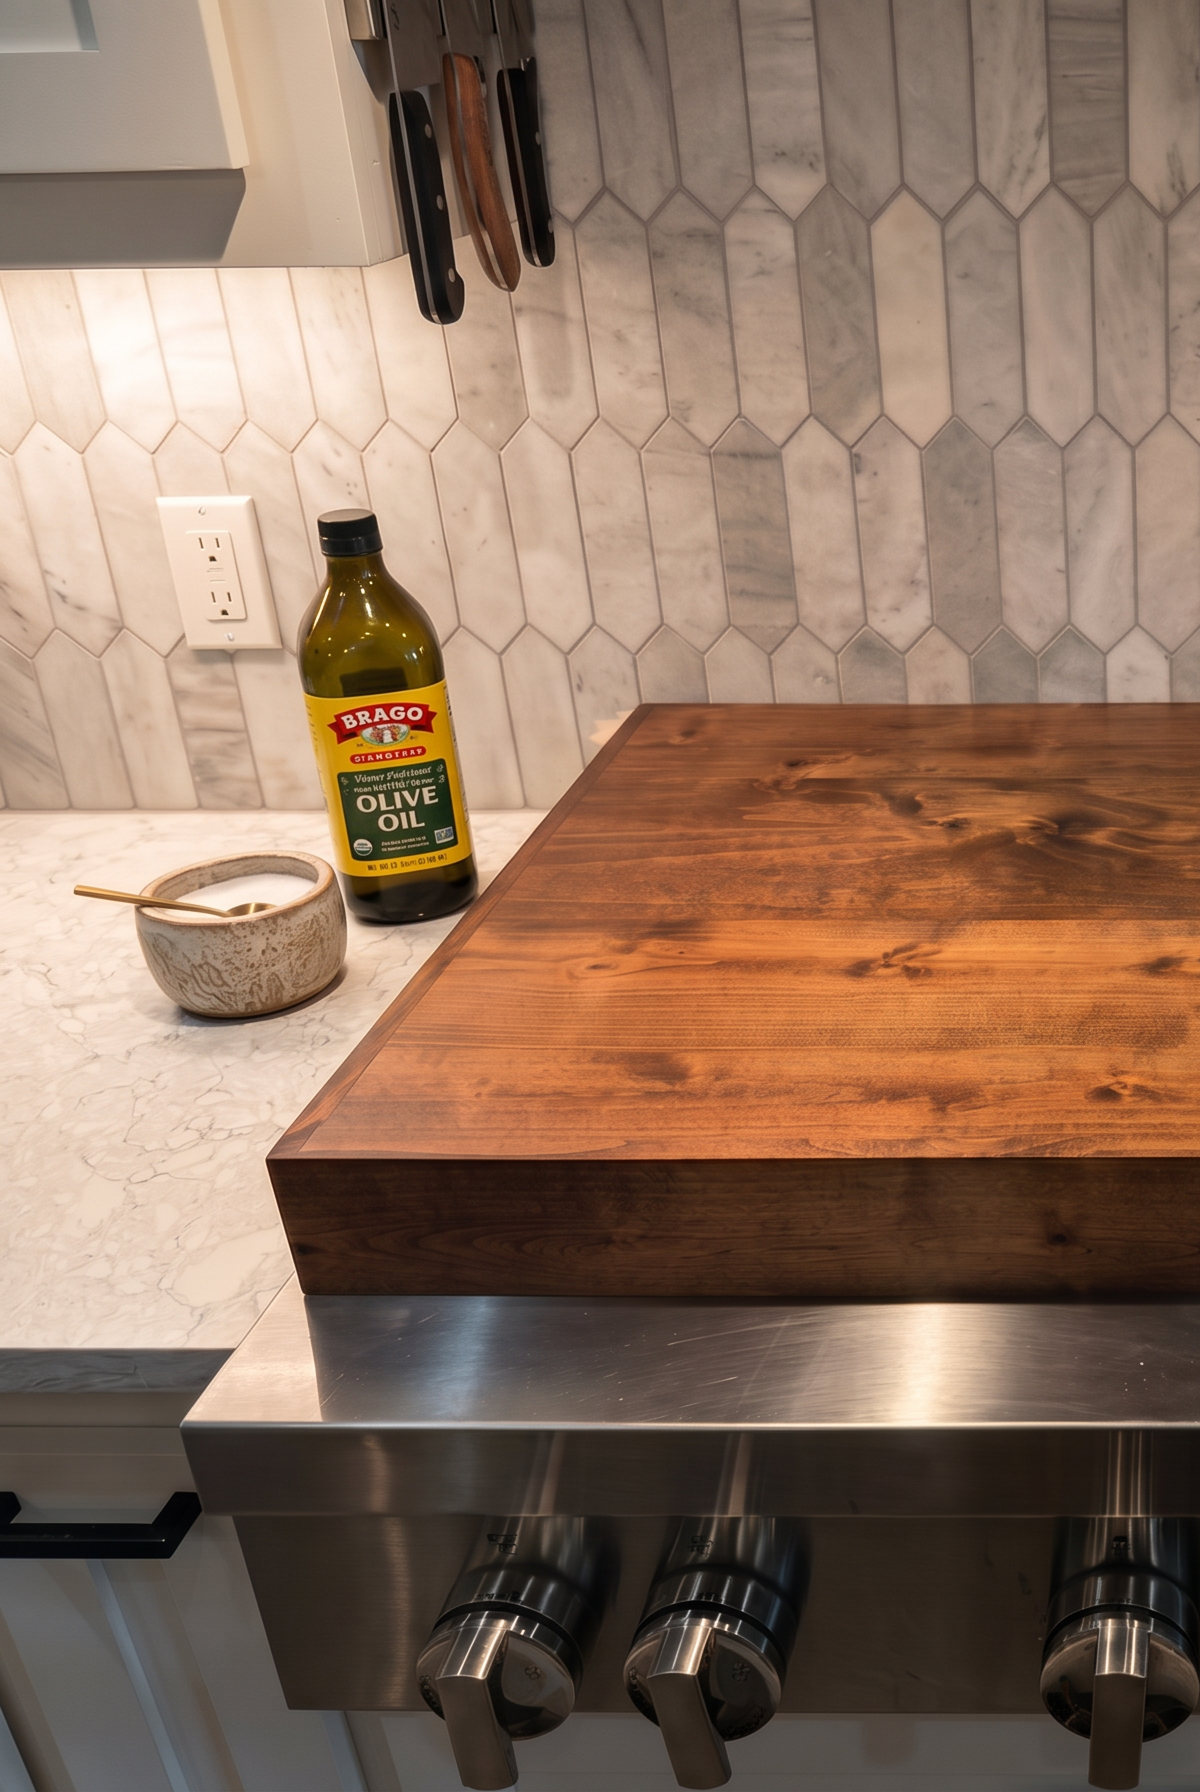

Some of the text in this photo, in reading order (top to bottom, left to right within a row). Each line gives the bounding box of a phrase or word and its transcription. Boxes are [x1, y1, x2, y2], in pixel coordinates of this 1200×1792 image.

[341, 706, 423, 730] BRAGO
[356, 786, 439, 813] OLIVE
[378, 810, 425, 832] OIL
